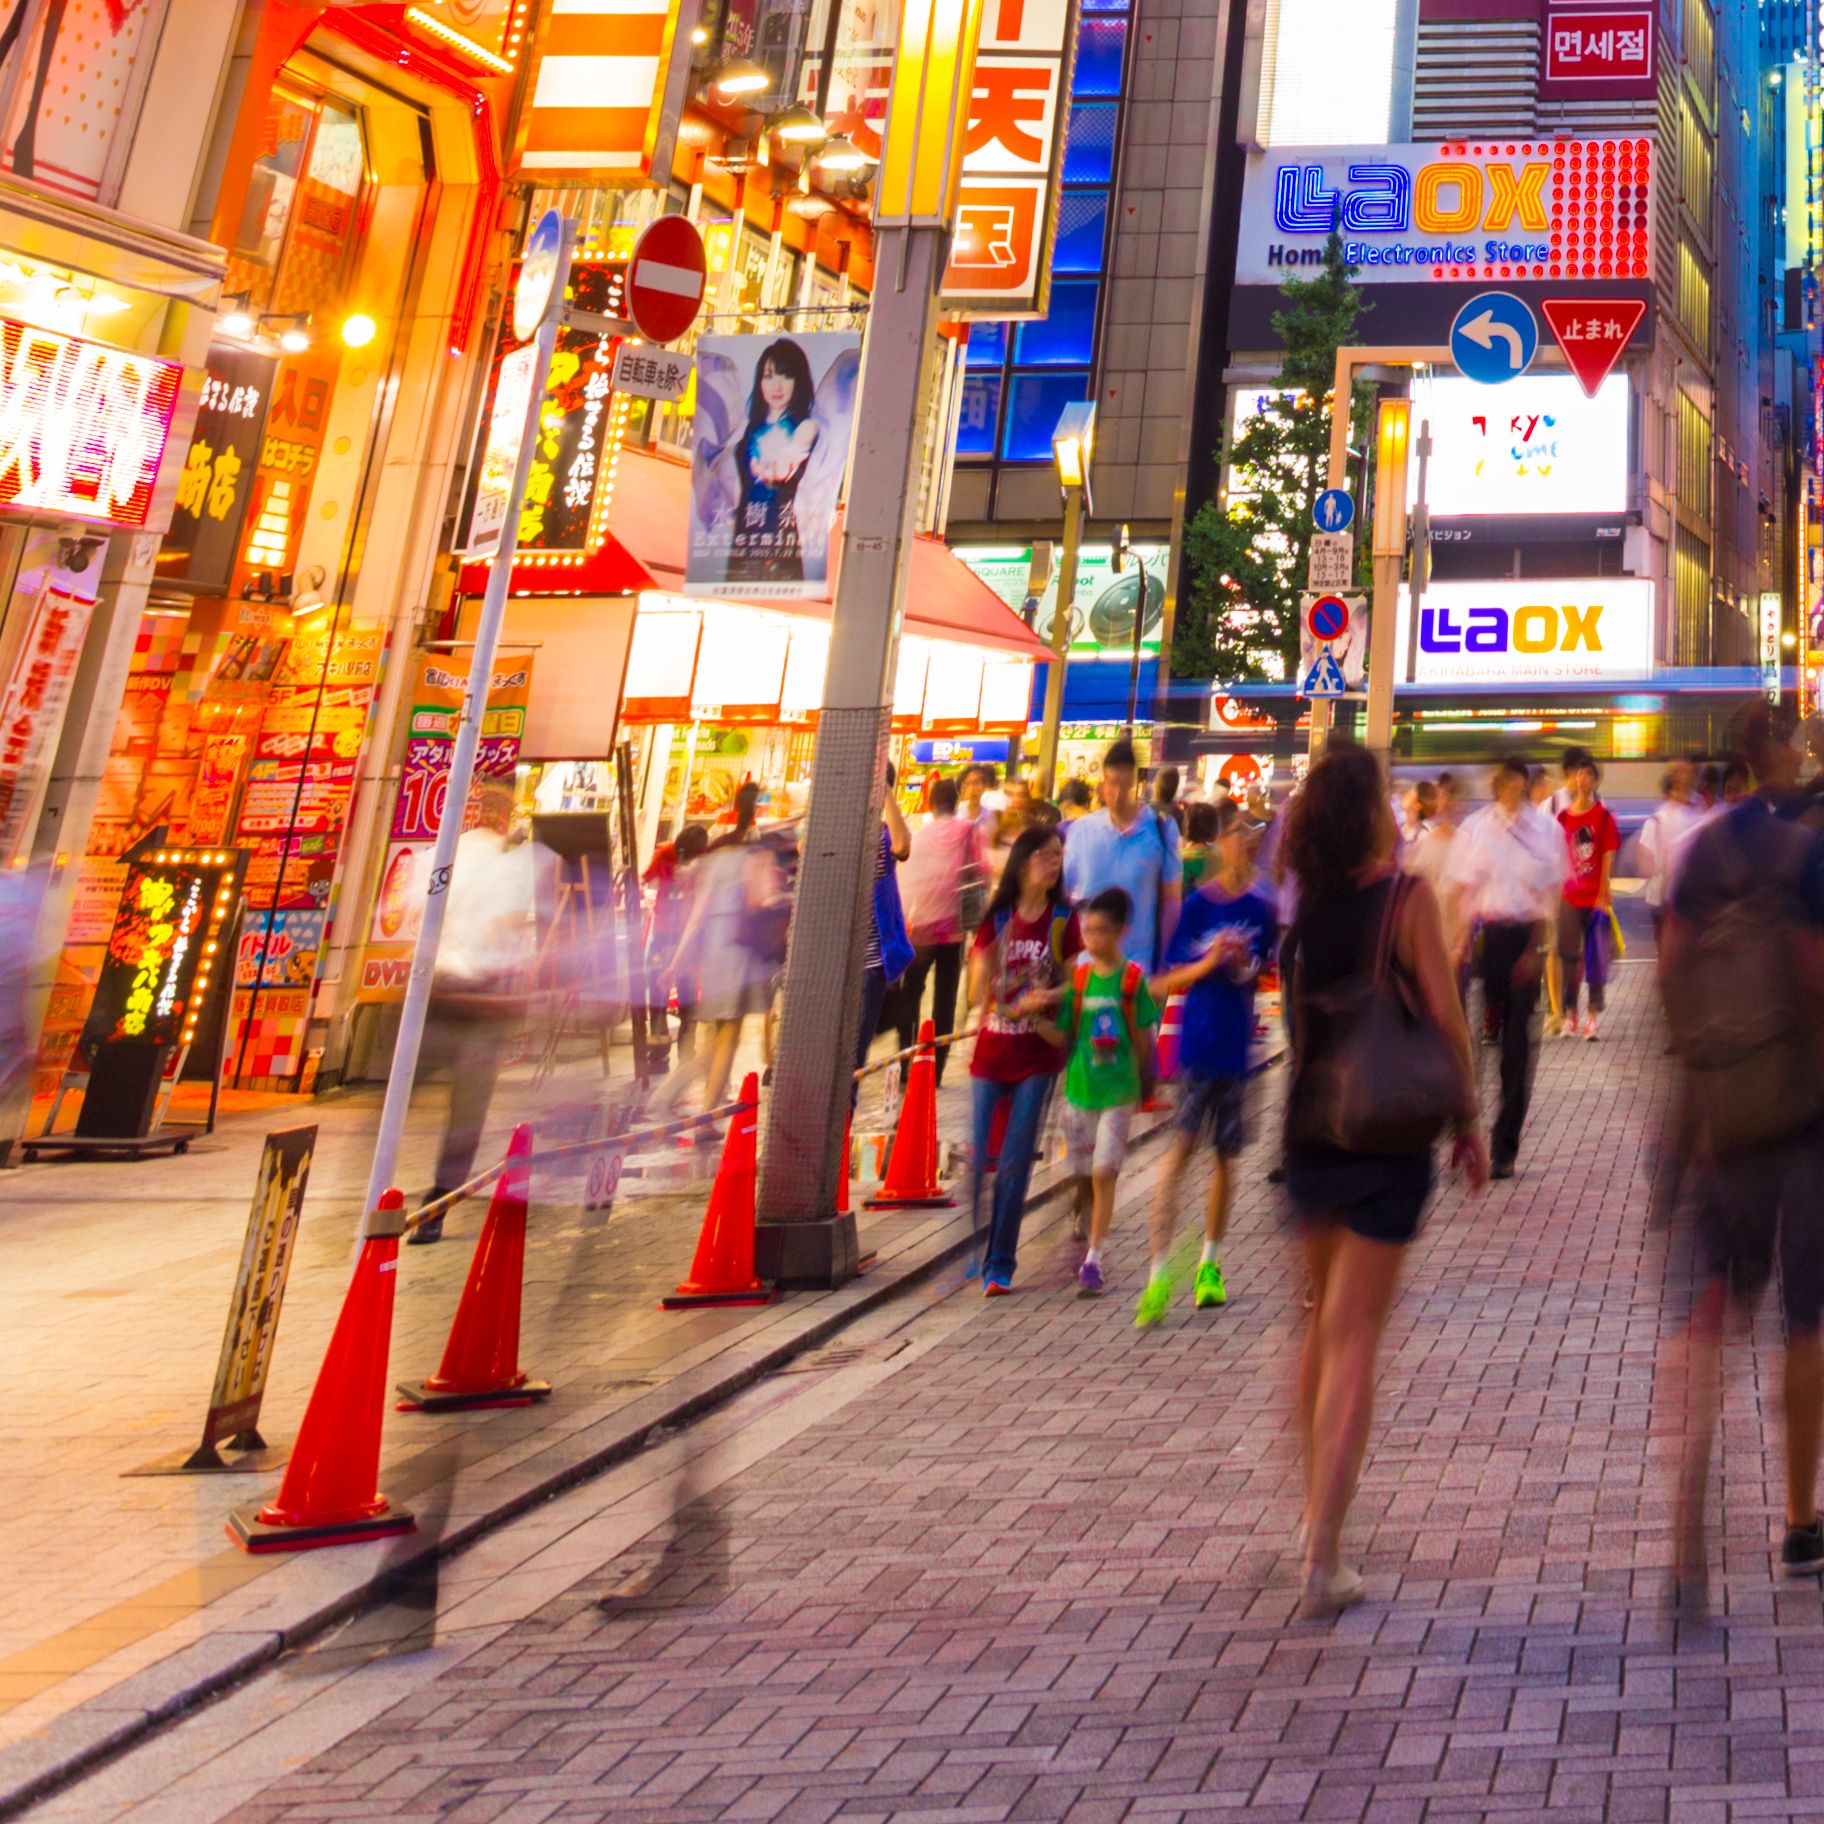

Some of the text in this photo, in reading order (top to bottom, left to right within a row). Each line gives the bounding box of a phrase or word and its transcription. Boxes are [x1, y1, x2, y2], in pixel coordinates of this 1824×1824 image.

[1553, 27, 1647, 63] 면세점
[1268, 240, 1549, 267] Hom Electronics Store
[1563, 319, 1625, 341] 止まれ
[618, 354, 688, 393] 自転車を除く
[271, 368, 331, 433] 入口
[259, 436, 317, 478] はコチラ
[1418, 662, 1604, 677] AKIHABARA MAIN STORE
